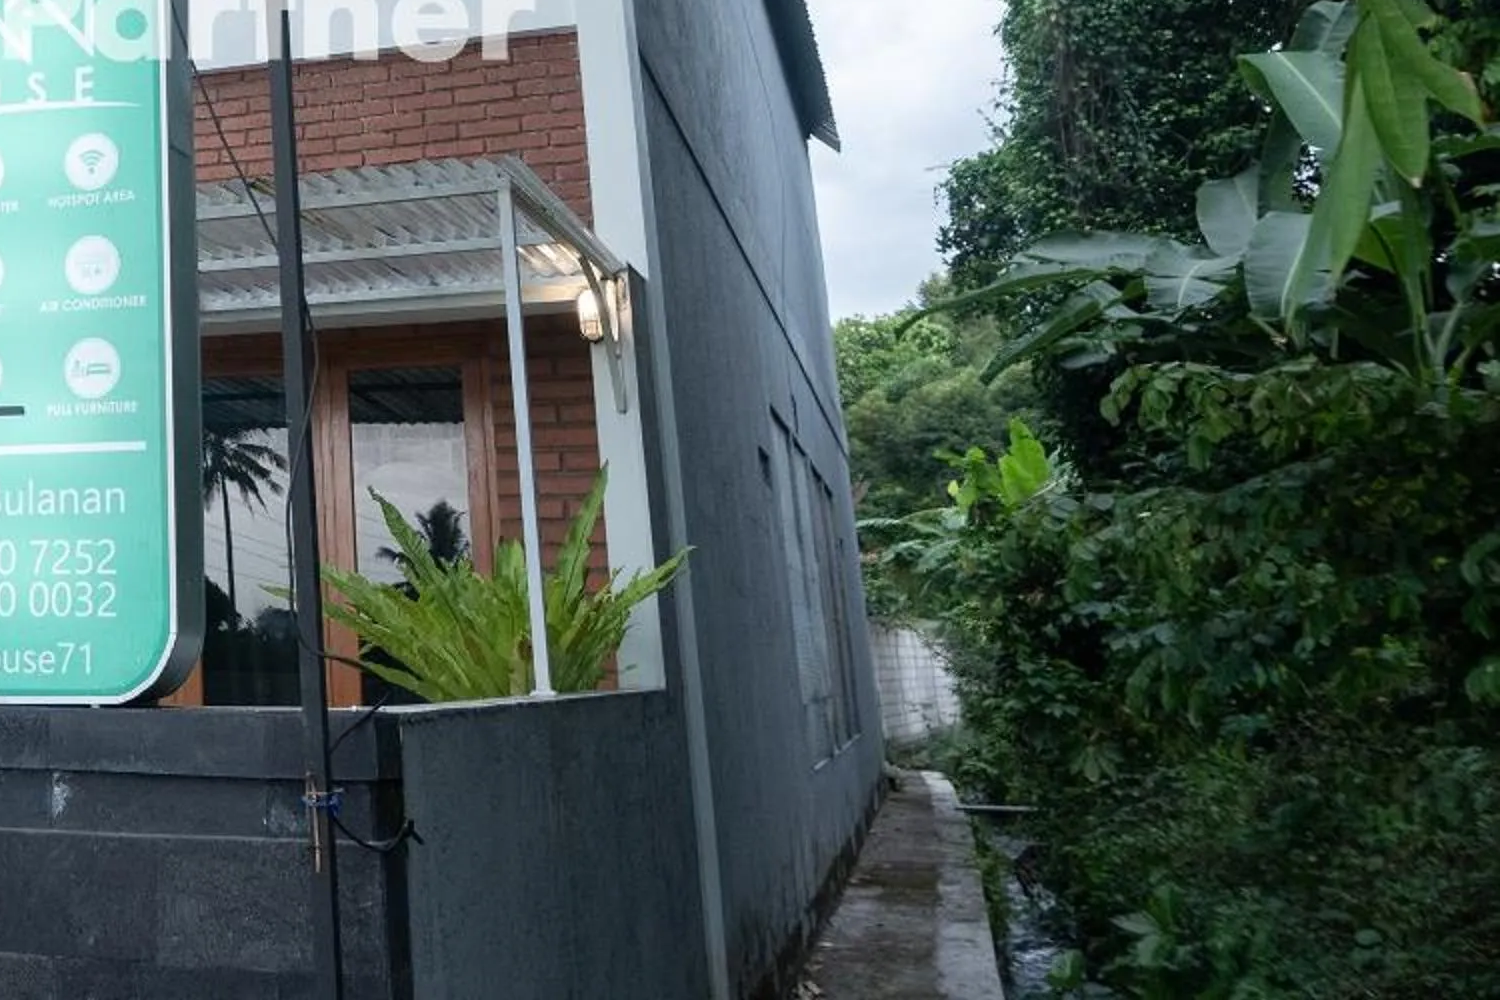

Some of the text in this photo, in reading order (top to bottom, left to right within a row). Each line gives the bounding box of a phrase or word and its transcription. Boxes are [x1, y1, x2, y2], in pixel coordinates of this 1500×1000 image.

[47, 189, 136, 209] HOTSPOT AREA
[39, 299, 59, 313] AIR
[29, 539, 118, 576] 7252
[29, 580, 118, 618] 0032
